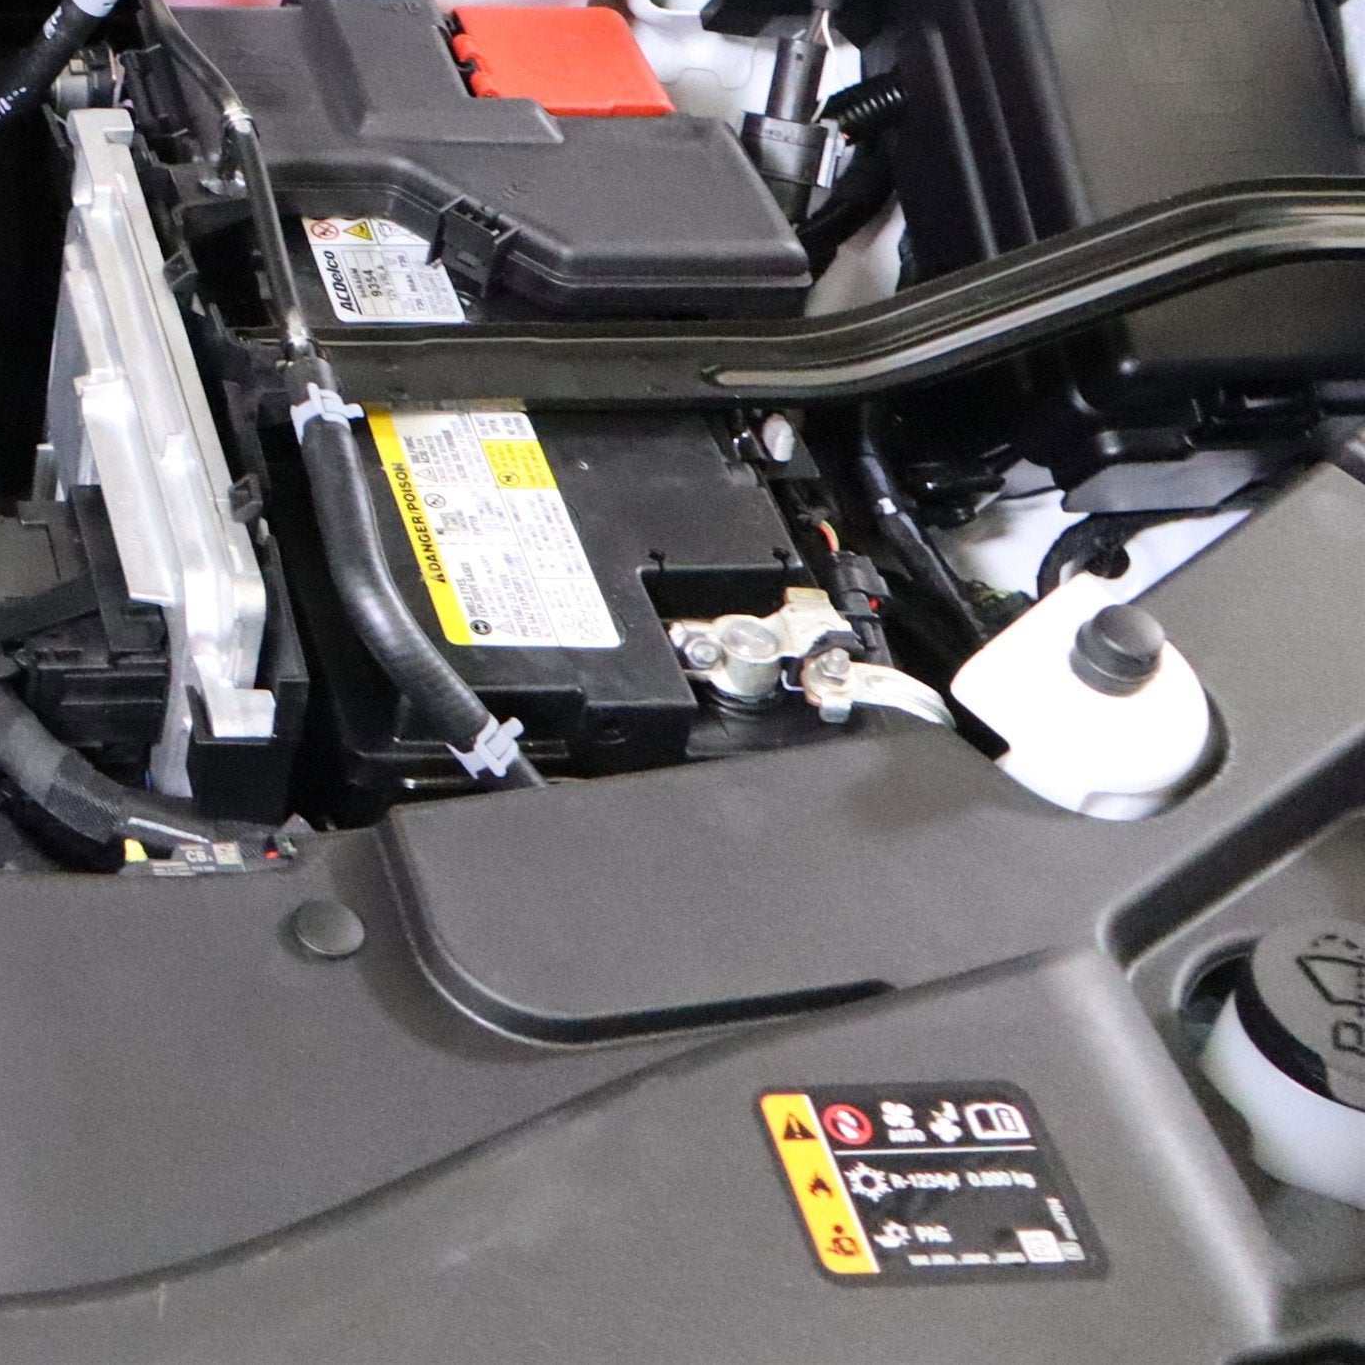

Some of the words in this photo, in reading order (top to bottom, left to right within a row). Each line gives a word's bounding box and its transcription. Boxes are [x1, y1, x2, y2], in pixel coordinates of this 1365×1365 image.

[324, 250, 355, 312] ACDelco
[366, 269, 383, 297] 9354
[887, 1128, 927, 1143] AUTO
